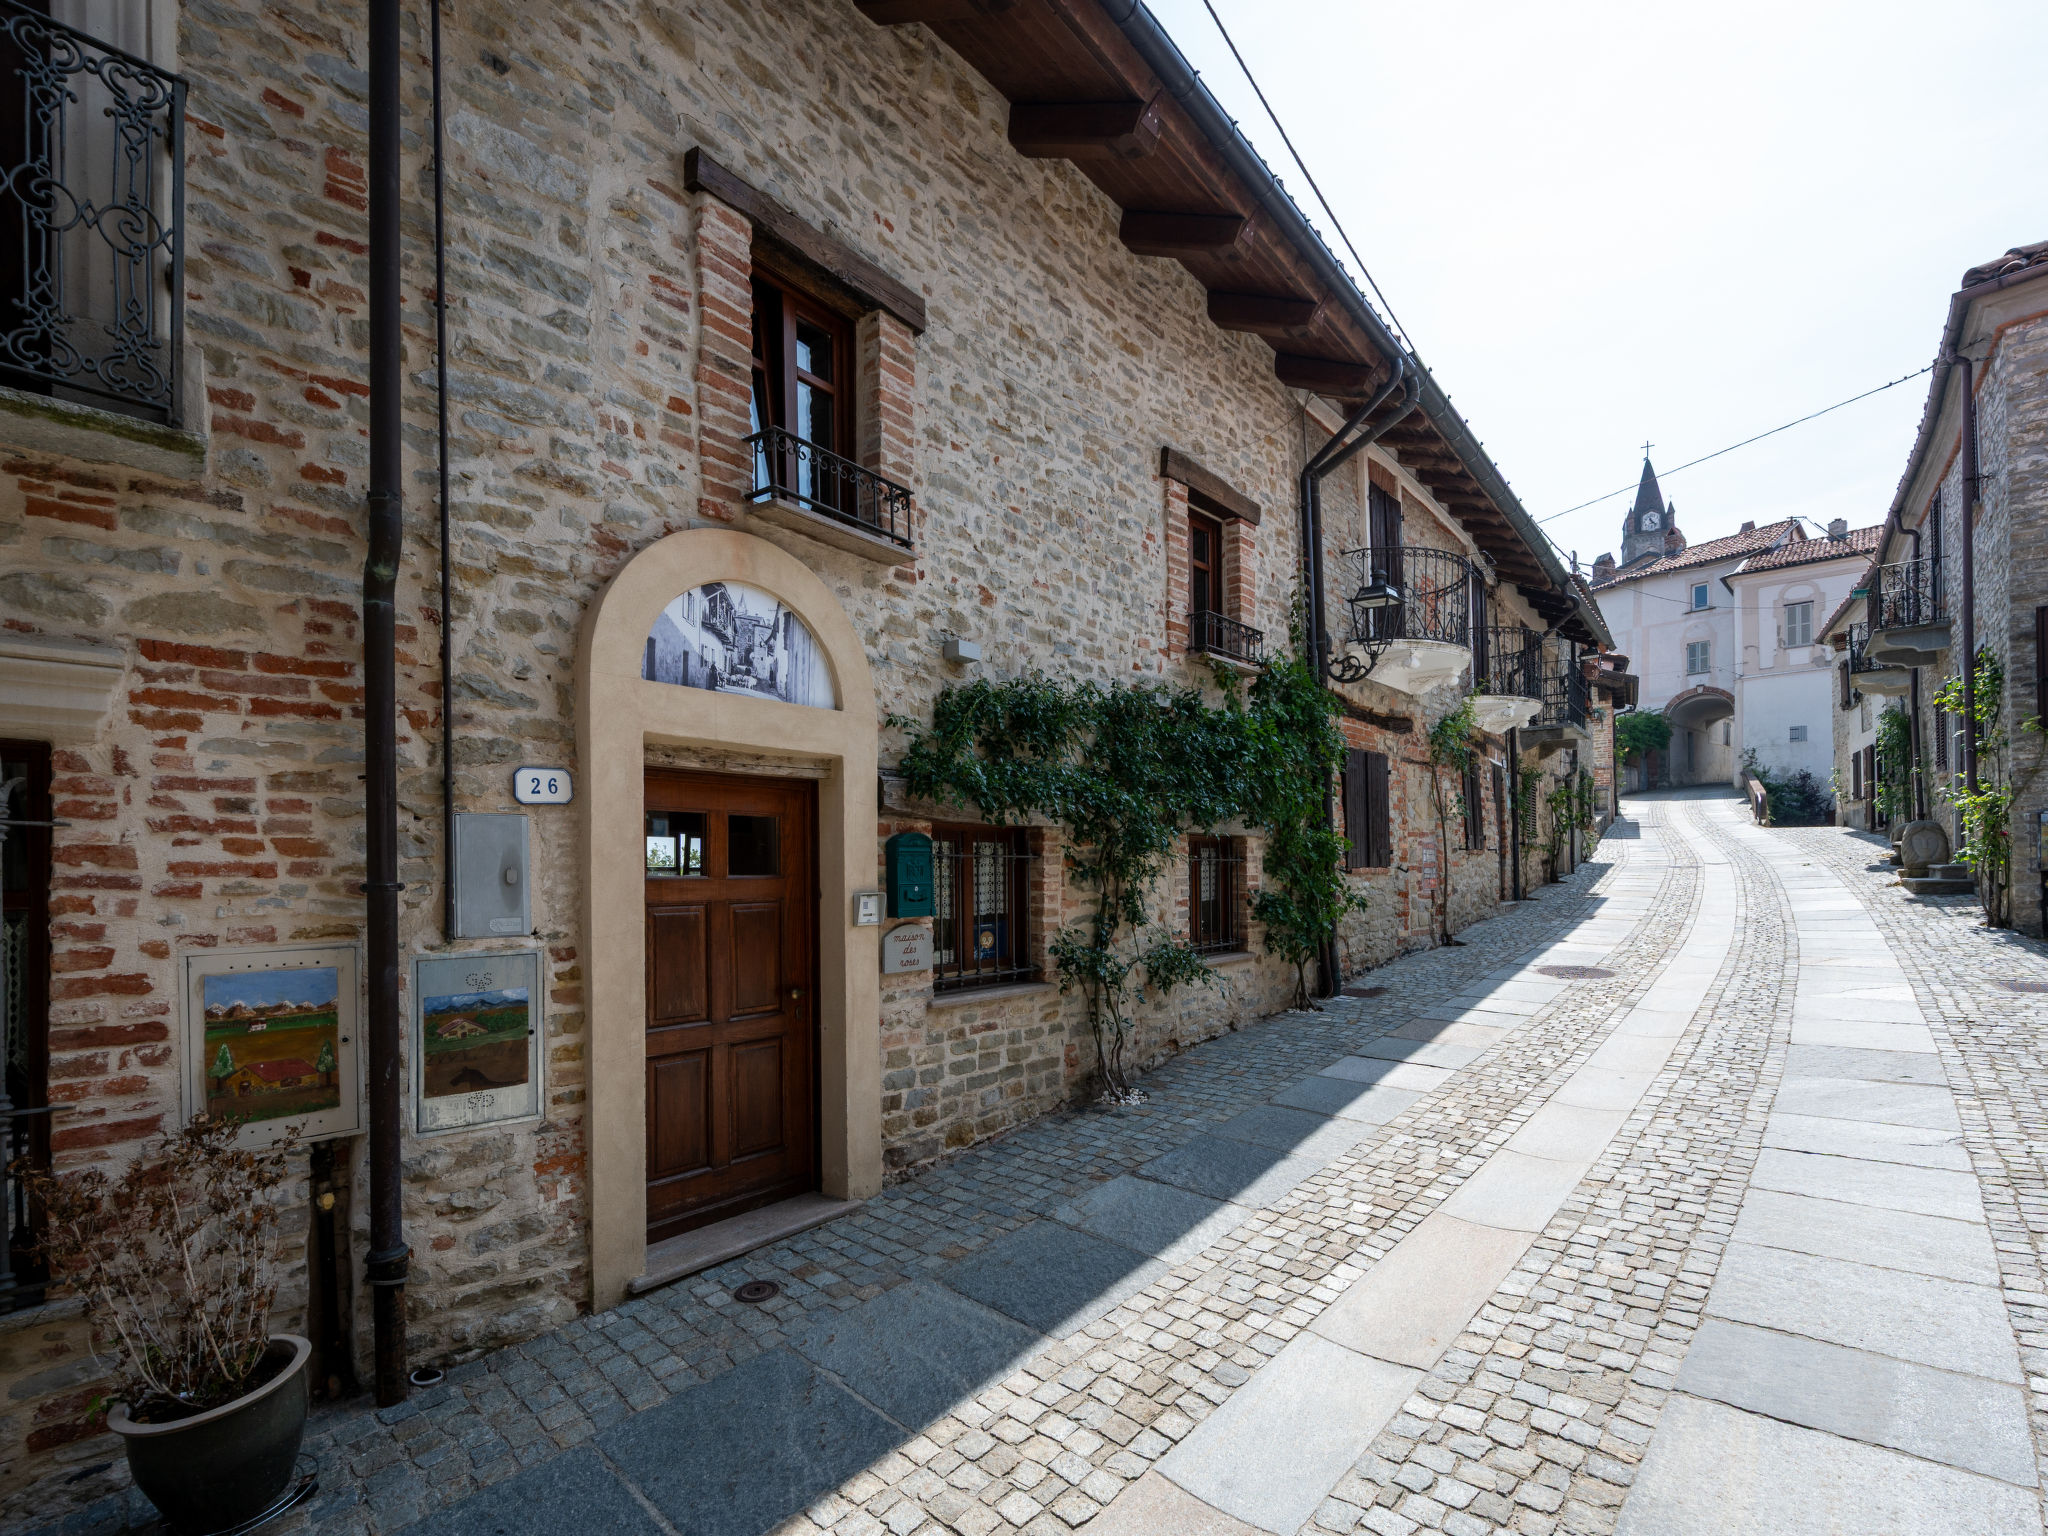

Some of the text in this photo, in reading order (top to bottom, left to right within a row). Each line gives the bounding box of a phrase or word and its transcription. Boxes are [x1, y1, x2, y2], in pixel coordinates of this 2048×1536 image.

[530, 777, 558, 795] 26
[903, 942, 917, 954] des
[465, 972, 493, 992] GAS
